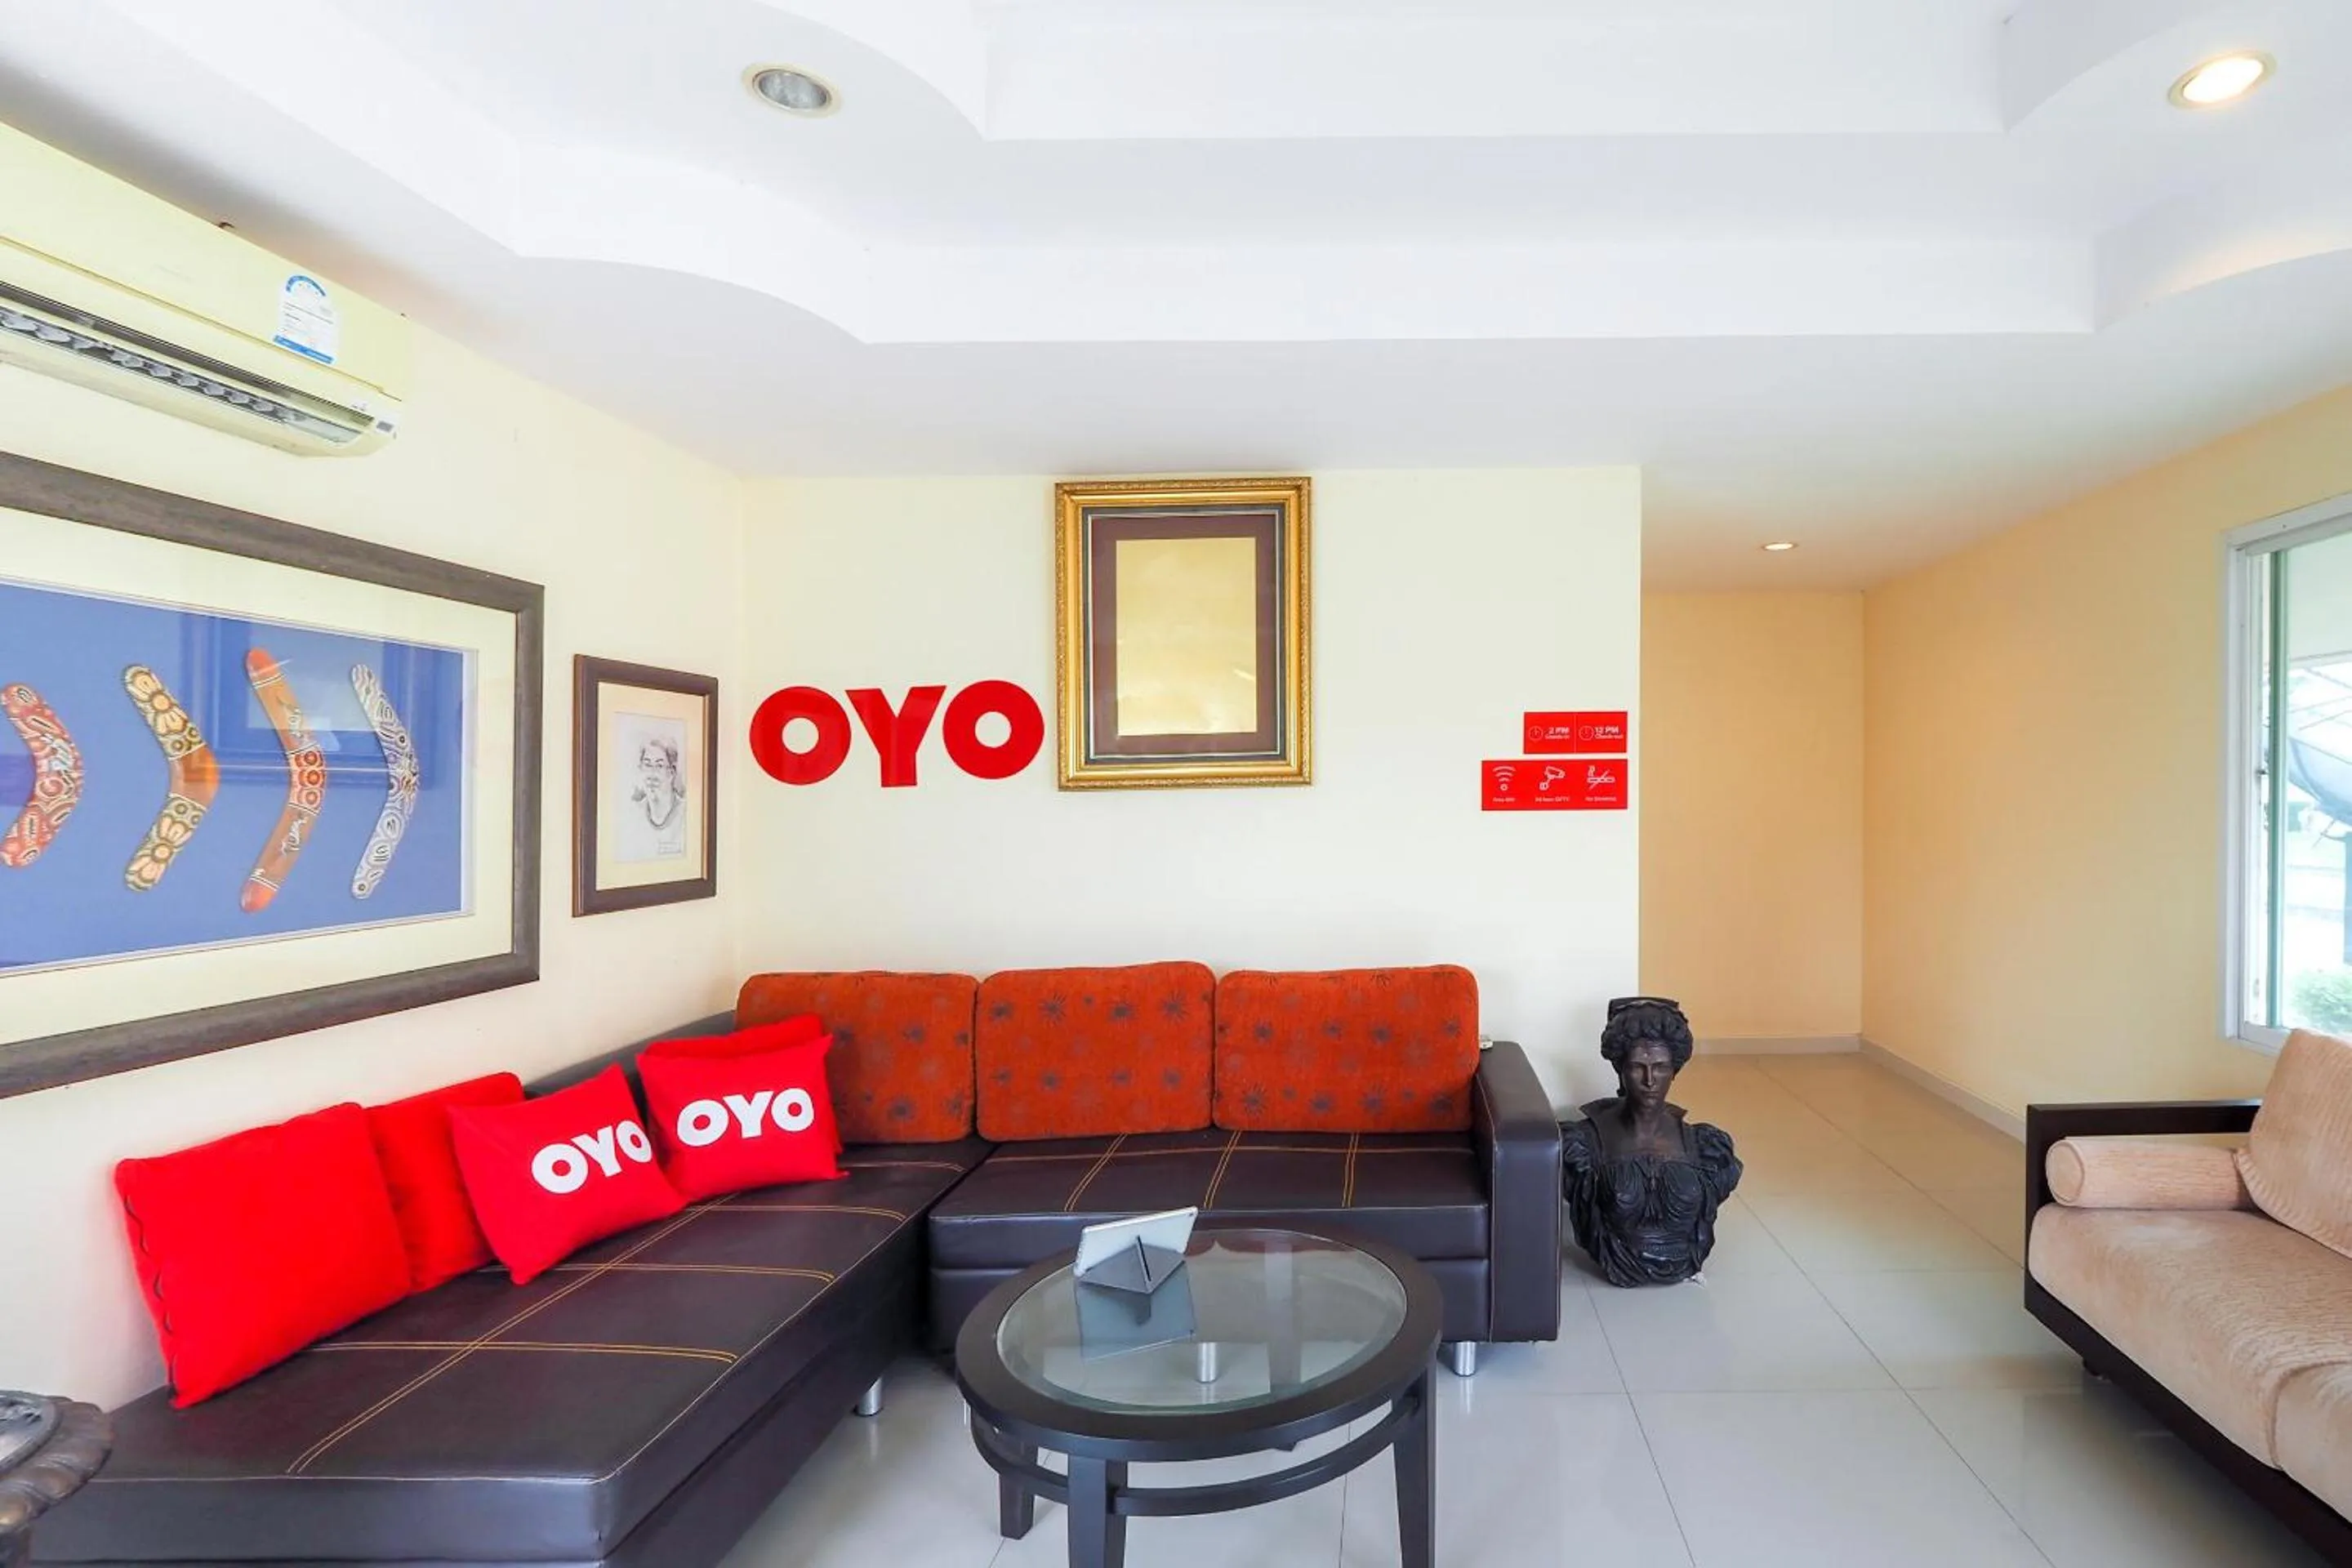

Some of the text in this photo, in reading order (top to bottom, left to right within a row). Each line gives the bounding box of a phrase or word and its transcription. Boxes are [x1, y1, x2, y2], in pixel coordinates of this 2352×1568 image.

[750, 680, 1045, 787] OYO
[1605, 725, 1619, 734] PM
[678, 1088, 814, 1147] OYO
[532, 1120, 652, 1194] OYO
